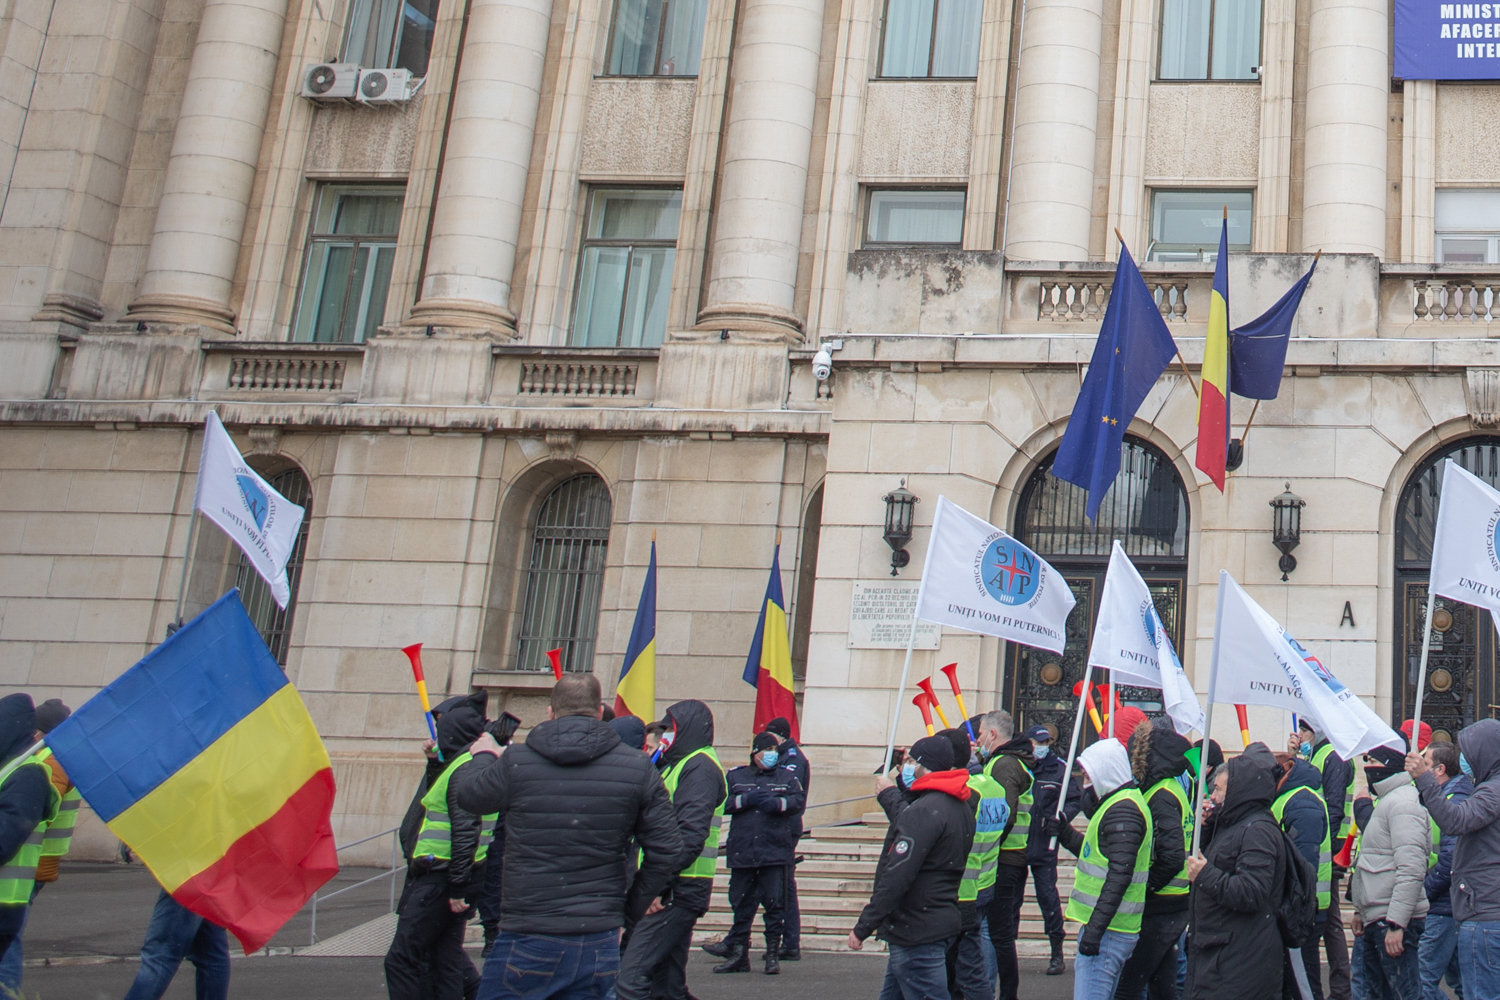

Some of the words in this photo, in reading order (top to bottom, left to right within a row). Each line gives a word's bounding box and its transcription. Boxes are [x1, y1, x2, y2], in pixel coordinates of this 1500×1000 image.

[1486, 517, 1500, 572] SINDICATUL
[974, 549, 988, 597] SINDICATUL
[981, 531, 1005, 549] NATION
[996, 545, 1008, 564] S
[1021, 551, 1037, 574] N
[988, 569, 1005, 591] A
[1017, 575, 1031, 595] P
[978, 610, 1002, 624] VOM
[1002, 617, 1012, 626] FI
[1340, 600, 1356, 627] A
[1150, 658, 1161, 670] VO
[1286, 687, 1304, 700] VO
